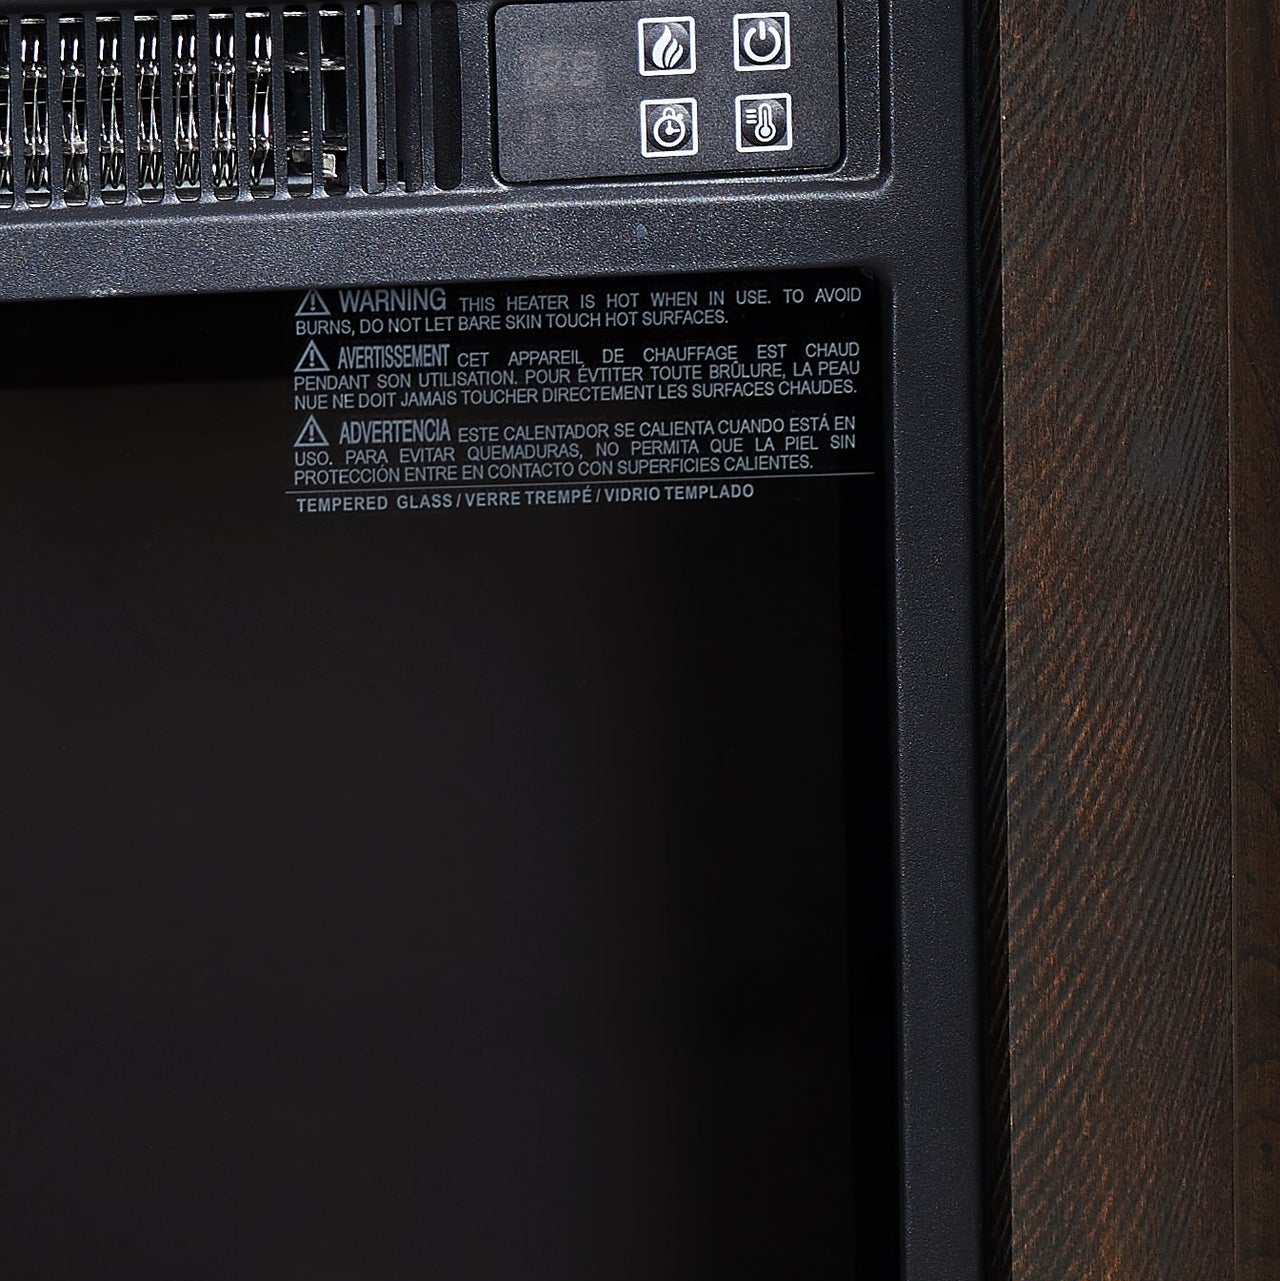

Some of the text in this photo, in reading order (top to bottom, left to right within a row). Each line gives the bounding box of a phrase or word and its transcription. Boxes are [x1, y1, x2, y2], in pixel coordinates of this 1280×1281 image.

[340, 287, 861, 313] WARNING THIS HEATER IS HOT WHEN IN USE. TO AVOID
[296, 309, 728, 336] BURNS, DO NOT LET BARE SKIN TOUCH HOT SURFACES.
[338, 342, 859, 369] AVERTISSEMENT CET APPAREIL DE CHAUFFAGE EST CHAUD
[294, 360, 859, 391] PENDANT SON UTILISATION. POUR ÉVTITER TOUTE BRÛLURE, LA PEAU
[295, 379, 856, 410] NUE NE DOIT JAMAIS TOUCHER DIRECTEMENT LES SURFACES CHAUDES.
[339, 413, 855, 445] ADVERTENCIA ESTE CALENTADOR SE CALIENTA CUANDO ESTÁ EN
[295, 434, 855, 466] USO. PARA EVITAR QUEMADURAS, NO PERMITA QUE LA PIEL SIN
[295, 454, 813, 485] PROTECCIÓN ENTRE EN CONTACTO CON SUPERFICIES CALIENTES.
[296, 484, 754, 513] TEMPERED GLASS / VERRE TREMPÉ / VIDRIO TEMPLADO
